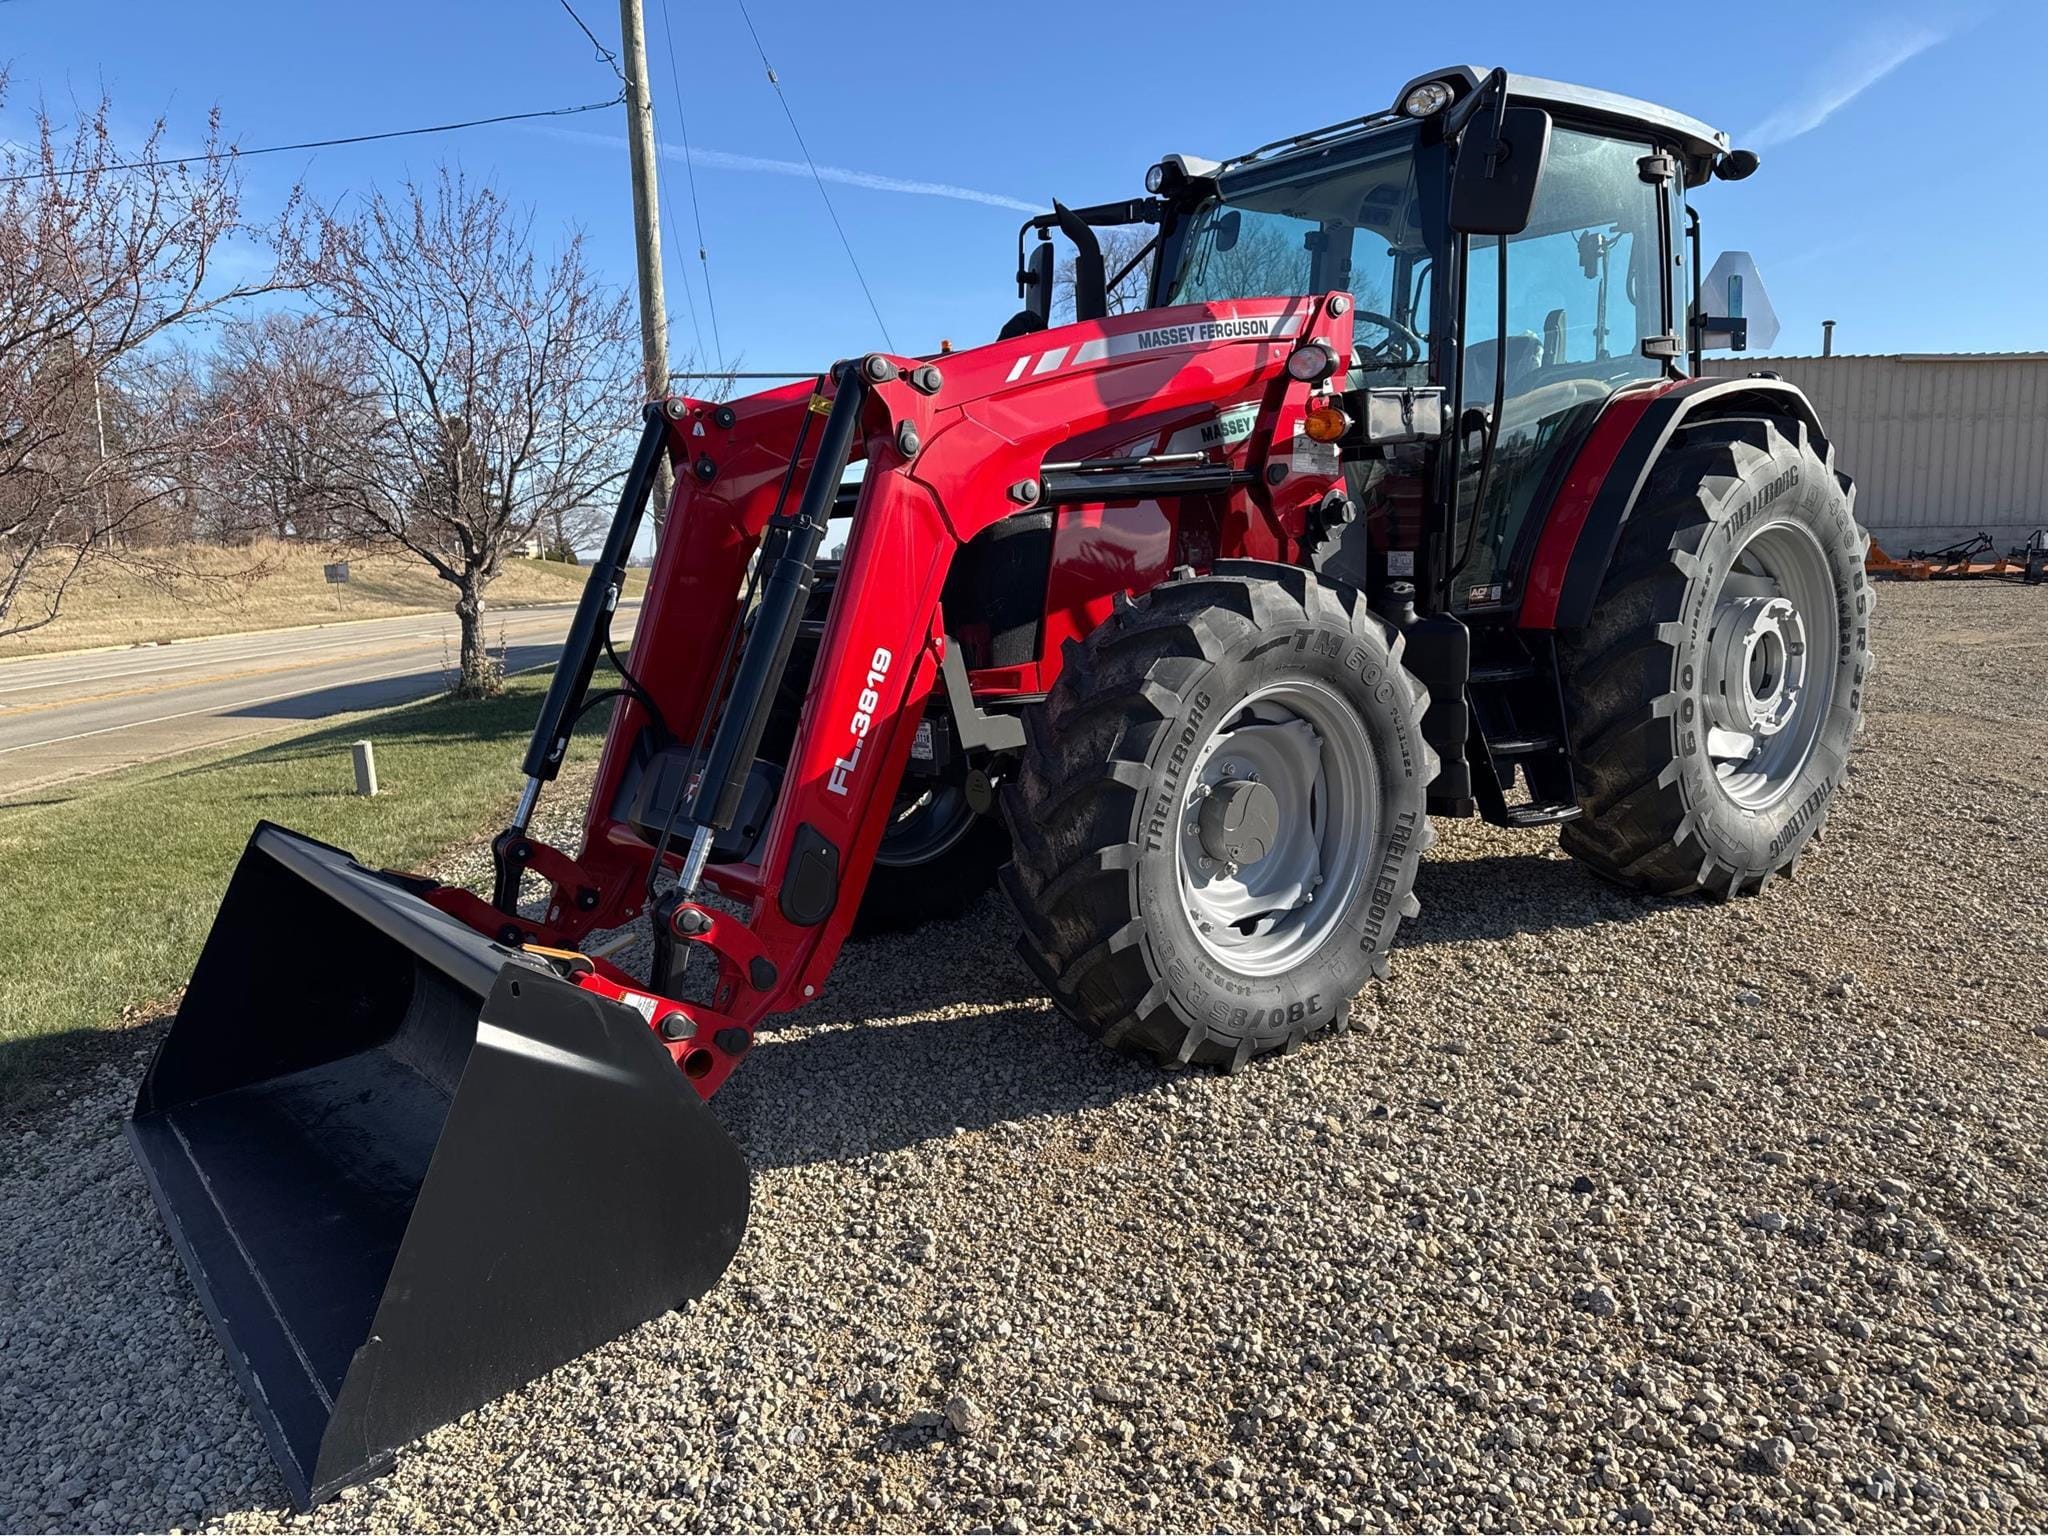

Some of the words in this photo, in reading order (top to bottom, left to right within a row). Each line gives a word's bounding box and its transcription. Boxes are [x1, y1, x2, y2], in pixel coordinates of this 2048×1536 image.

[1138, 326, 1195, 350] MASSEY
[1199, 319, 1270, 342] FERGUSON
[1200, 417, 1251, 443] MASSEY
[1722, 464, 1799, 545] TRELLEBORG
[1294, 628, 1346, 659] TM
[1344, 647, 1395, 704] 600
[827, 647, 893, 796] FL.3819
[1144, 691, 1212, 853] TRELLEBORG
[1768, 776, 1836, 860] TRELLEBORG
[1359, 811, 1417, 955] TRELLEBORG
[1186, 981, 1210, 1011] R
[1208, 993, 1323, 1030] 380/85
